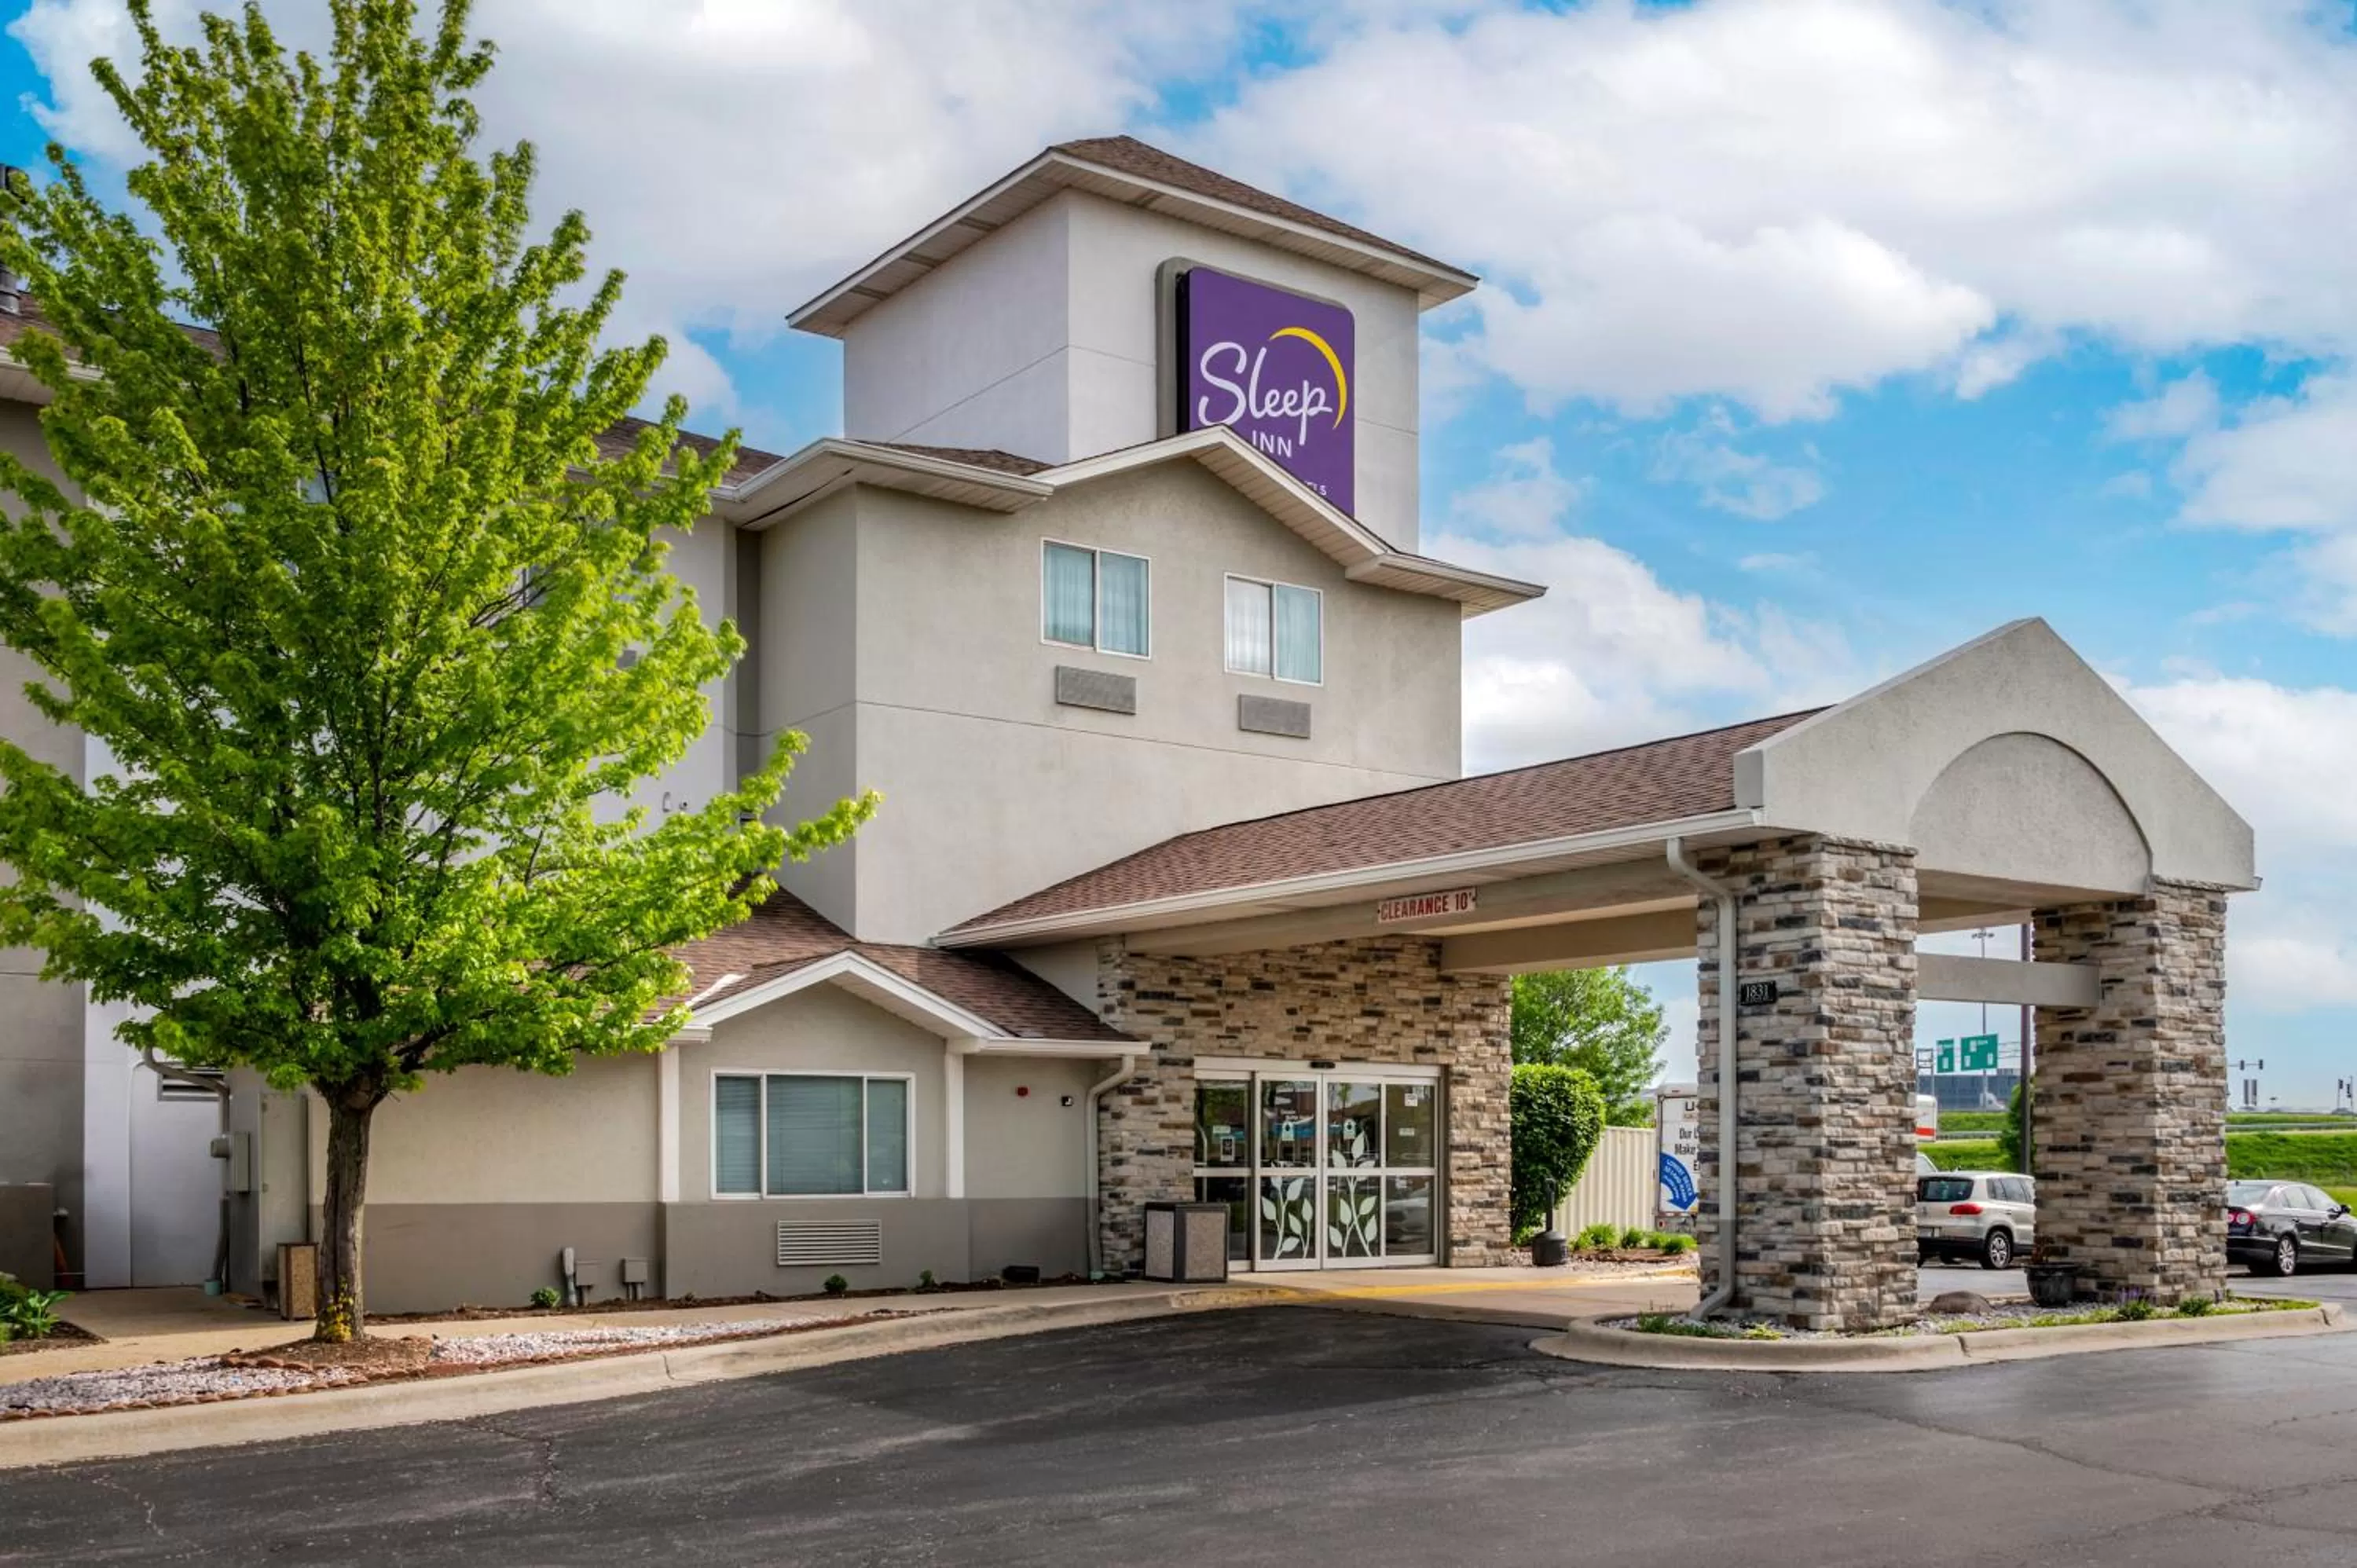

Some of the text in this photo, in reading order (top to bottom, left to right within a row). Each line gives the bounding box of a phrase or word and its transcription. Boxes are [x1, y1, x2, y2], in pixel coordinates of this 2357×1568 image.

[1198, 342, 1333, 446] Sleep
[1252, 430, 1293, 457] INN
[1380, 894, 1450, 920] CLEARANCE
[1679, 1127, 1692, 1139] Our
[1674, 1143, 1696, 1155] Make
